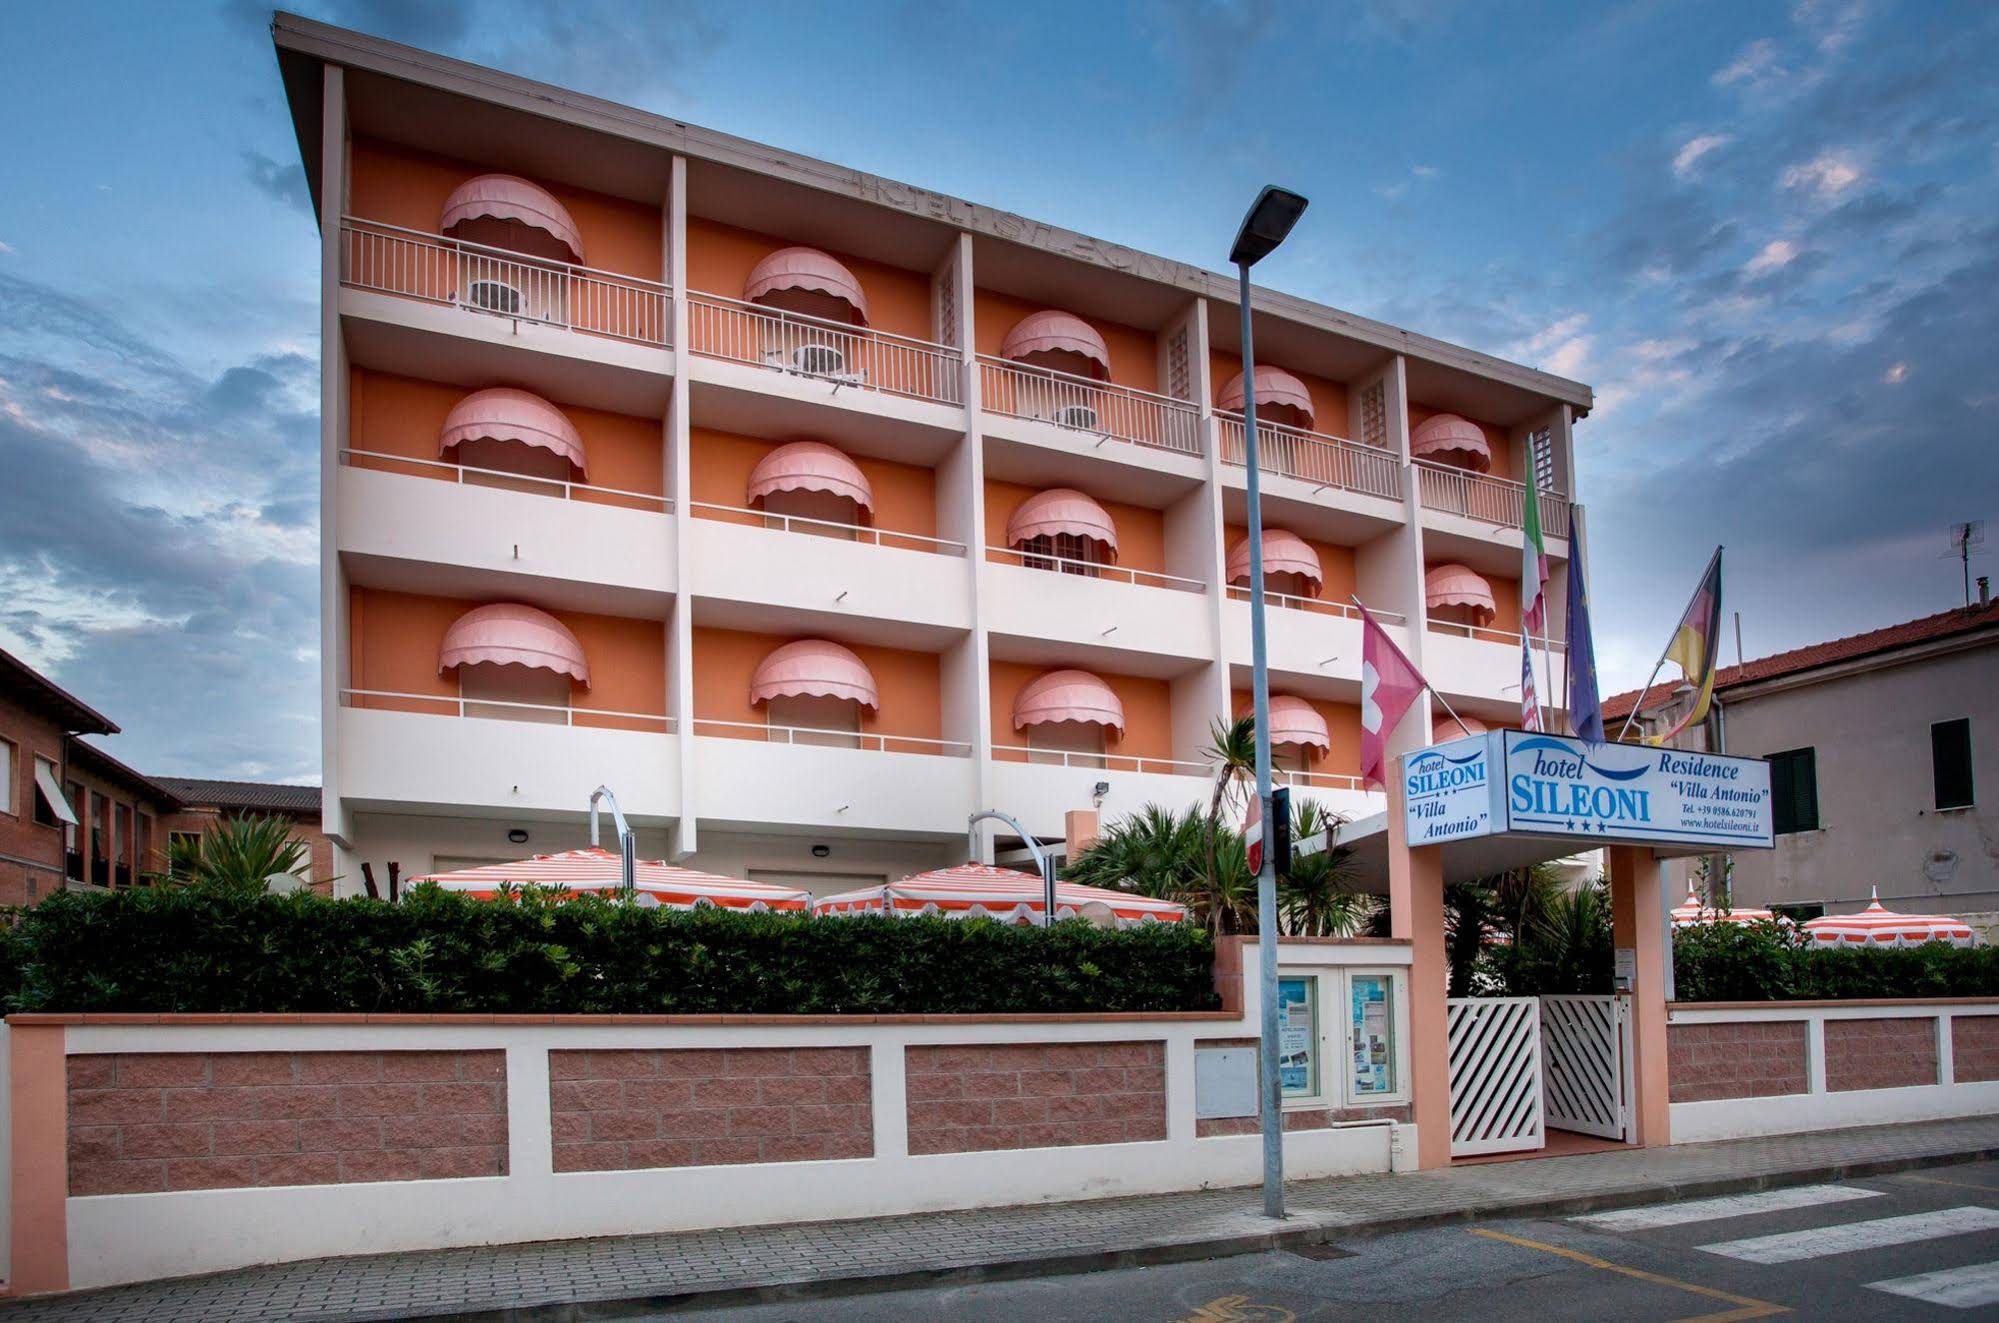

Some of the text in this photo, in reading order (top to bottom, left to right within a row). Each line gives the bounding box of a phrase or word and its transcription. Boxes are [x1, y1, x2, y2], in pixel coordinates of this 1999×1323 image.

[1419, 755, 1446, 773] hotel
[1533, 749, 1585, 780] hotel
[1658, 753, 1739, 780] Residence
[1408, 762, 1486, 796] SILEONI
[1511, 774, 1651, 822] SILEONI
[1671, 780, 1769, 804] “Villa Antonio”
[1409, 801, 1446, 819] “Villa
[1682, 804, 1695, 814] Tel.
[1698, 805, 1711, 815] +39
[1424, 813, 1488, 839] Antonio”
[1680, 818, 1760, 833] www.hotelsileoni.it
